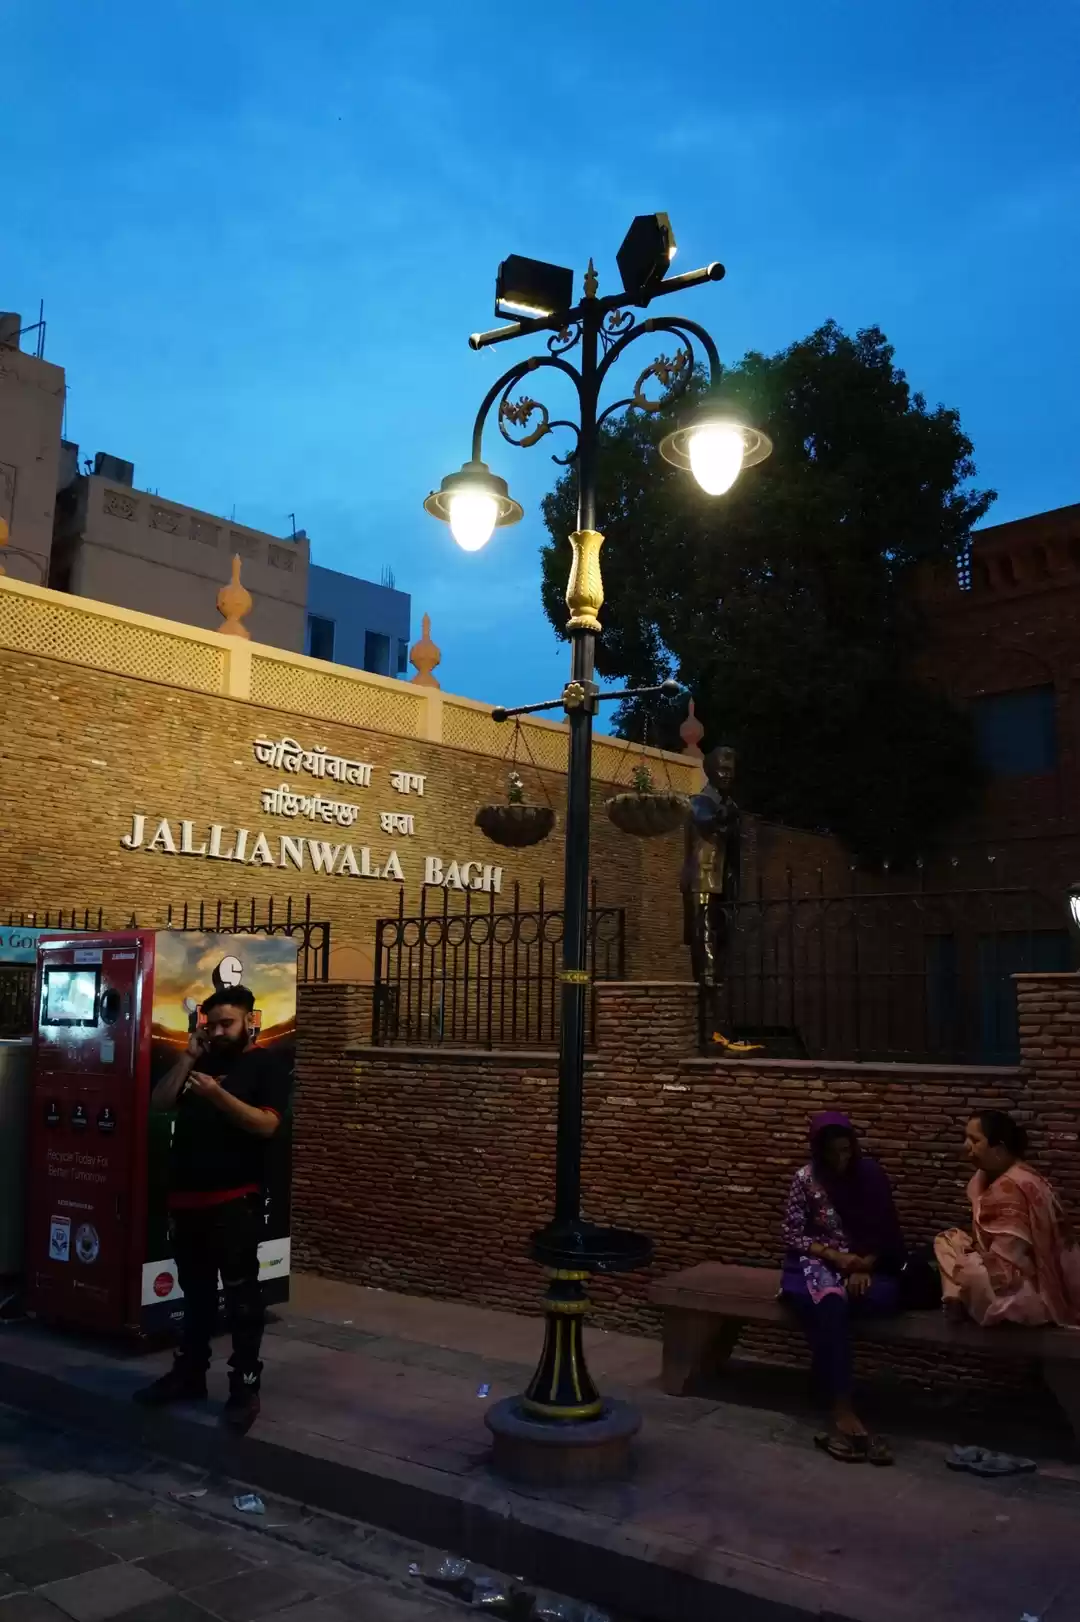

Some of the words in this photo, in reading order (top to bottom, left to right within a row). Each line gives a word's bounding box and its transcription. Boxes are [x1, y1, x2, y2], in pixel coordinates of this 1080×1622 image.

[390, 770, 427, 797] बाग
[120, 813, 405, 882] JALLIANWALA
[421, 856, 503, 893] BAGH
[76, 1105, 83, 1116] 2
[103, 1107, 110, 1119] 3
[74, 1150, 96, 1168] Today
